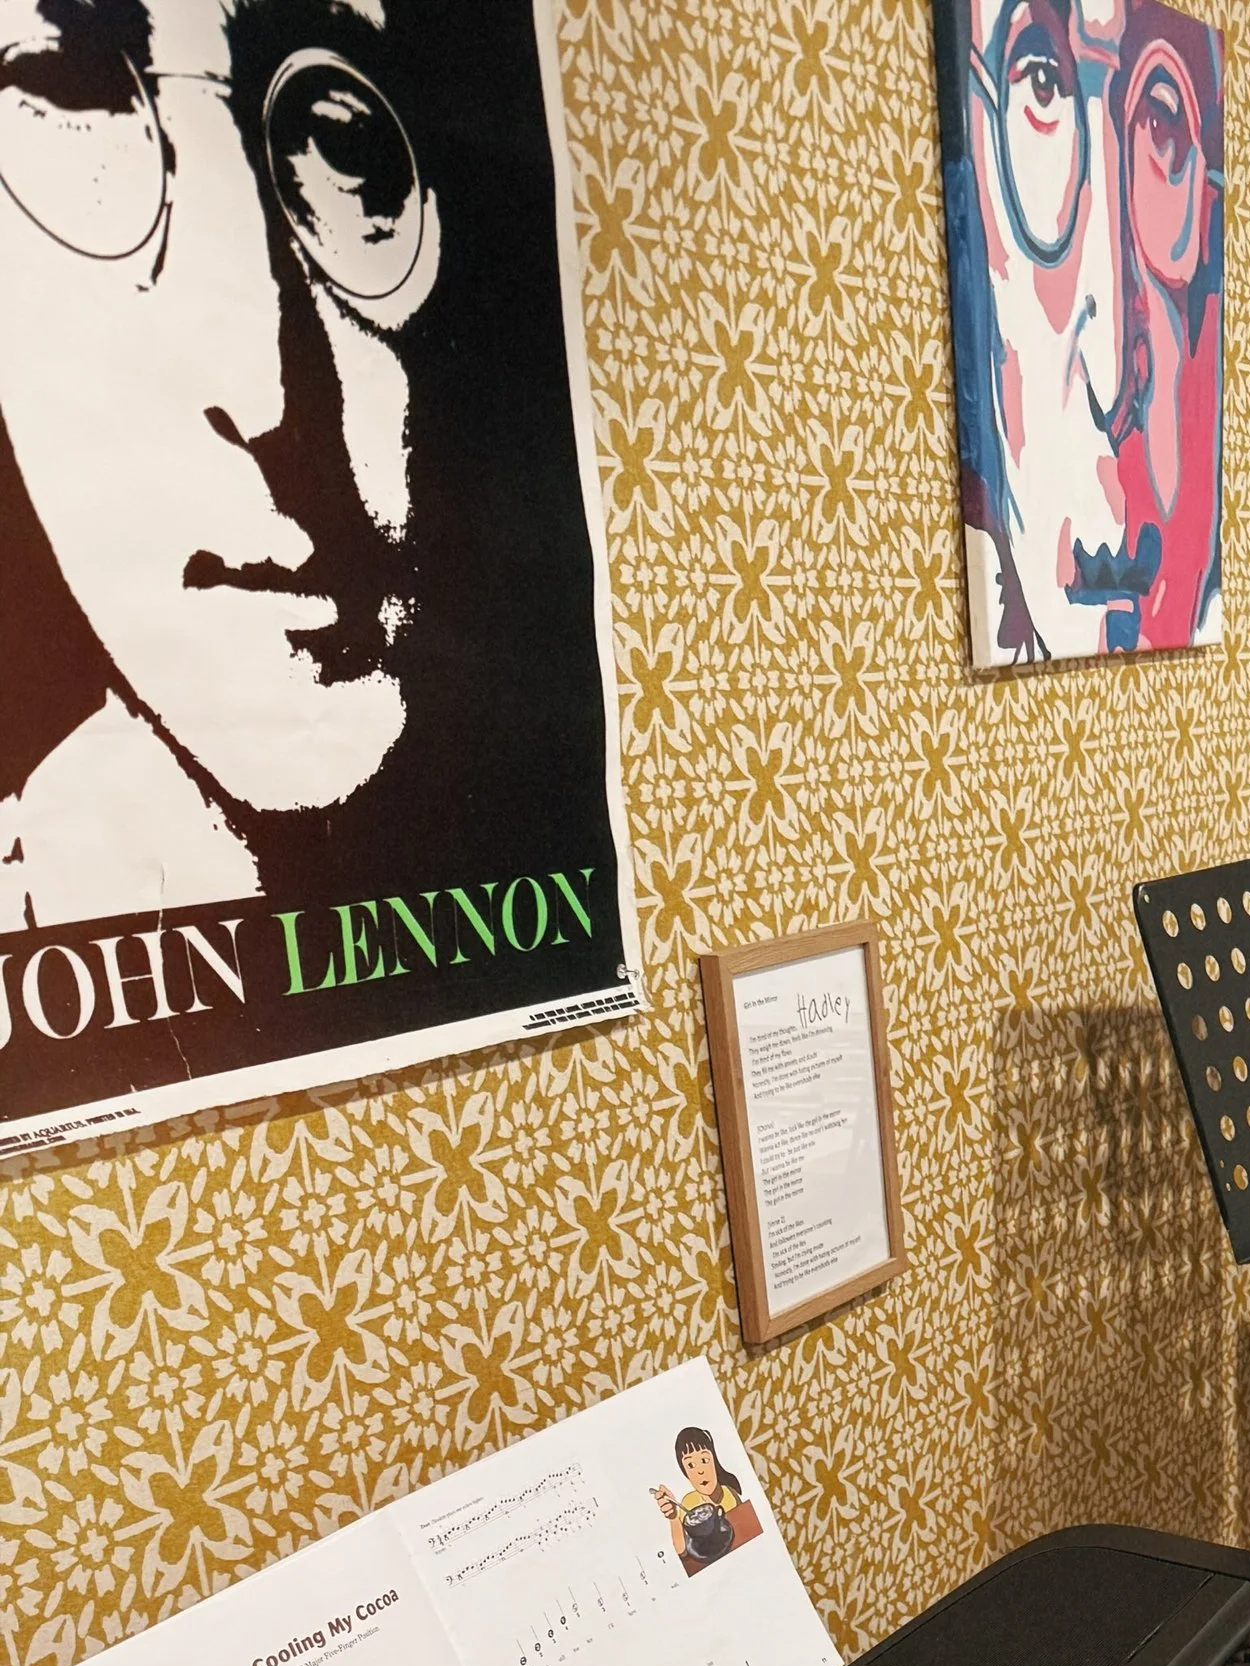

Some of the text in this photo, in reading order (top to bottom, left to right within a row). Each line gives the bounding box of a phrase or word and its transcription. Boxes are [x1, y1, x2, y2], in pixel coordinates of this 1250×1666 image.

[271, 868, 596, 996] LENNON
[796, 992, 850, 1029] Hadley
[327, 1615, 353, 1637] My
[355, 1589, 399, 1621] Cocoa
[323, 1637, 358, 1660] Five-Finger
[357, 1625, 380, 1641] Position
